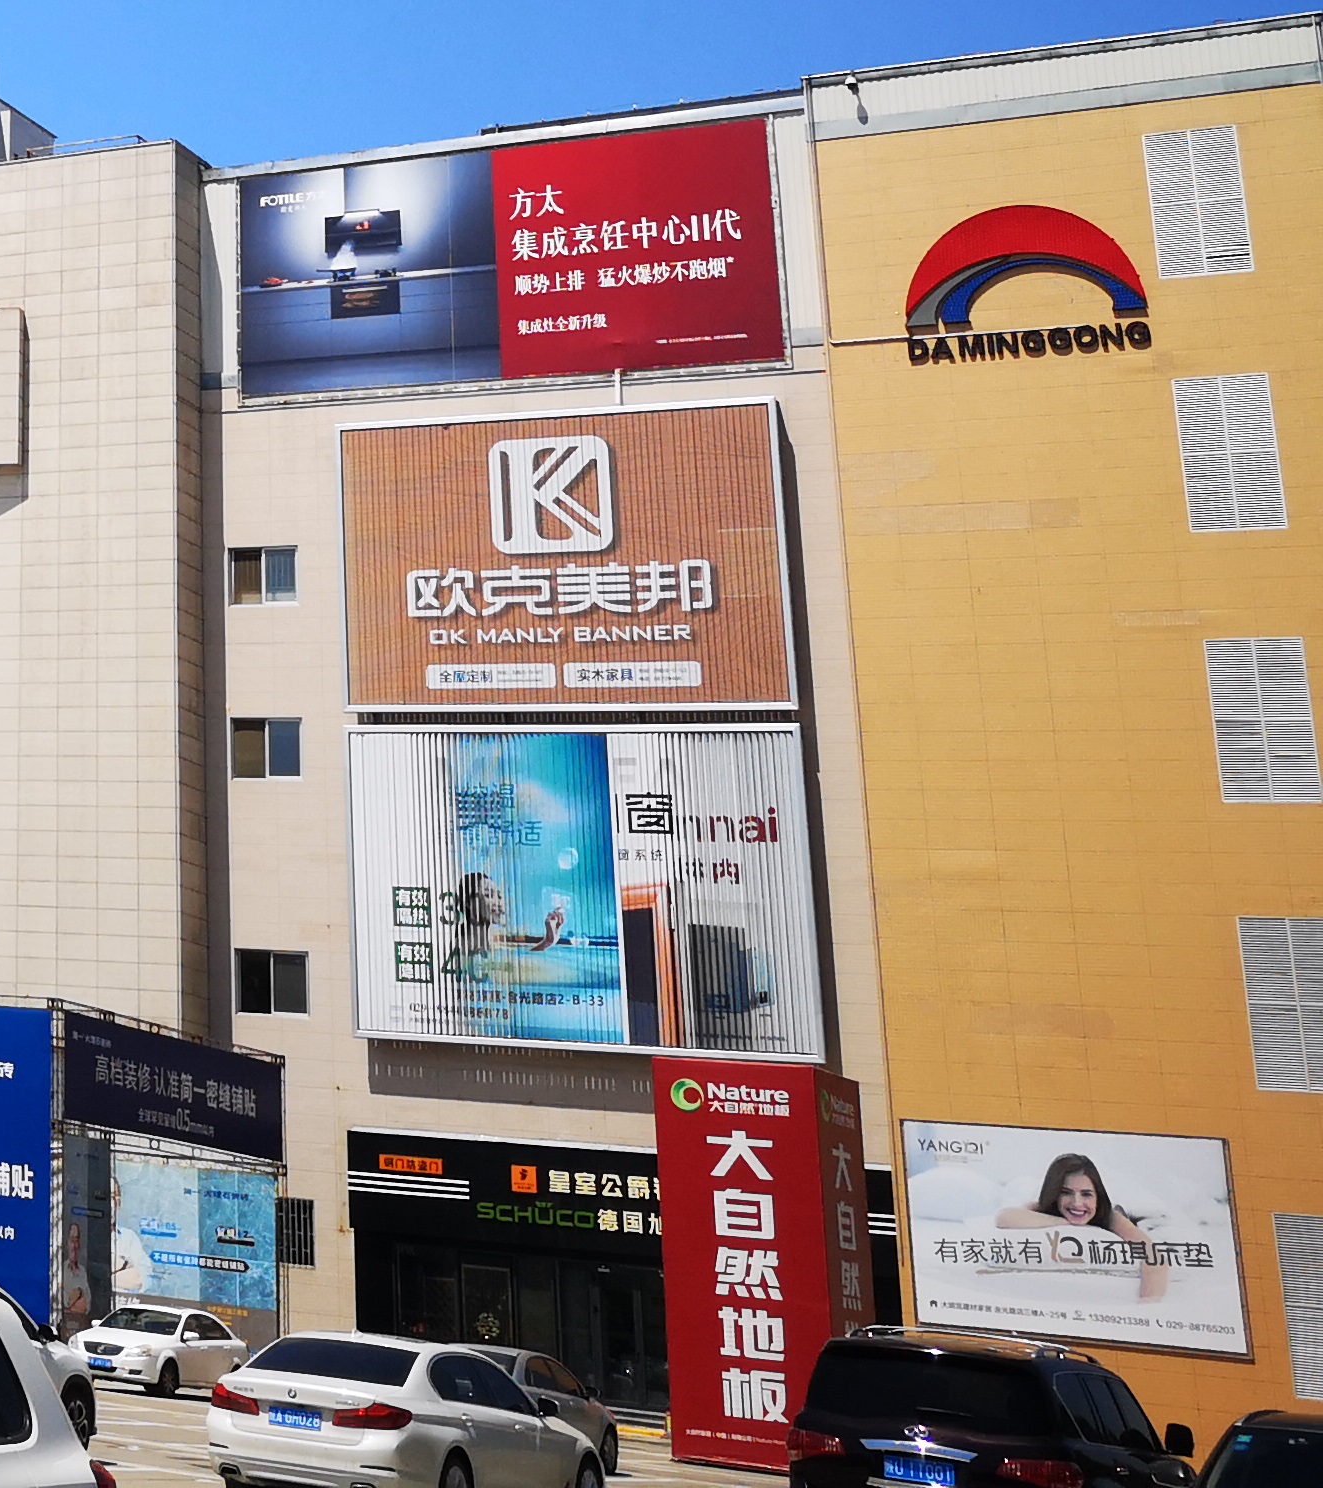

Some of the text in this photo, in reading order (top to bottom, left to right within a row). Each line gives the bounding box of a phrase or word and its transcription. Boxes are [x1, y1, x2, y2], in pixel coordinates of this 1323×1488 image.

[260, 193, 303, 207] FOTILE
[509, 184, 565, 221] 方太
[514, 269, 586, 296] 顺势上排
[518, 313, 607, 335] 集成灶全新升级
[907, 321, 1151, 366] DAMINGGONG
[406, 558, 713, 618] 欧克美邦
[477, 626, 562, 645] MANLY
[574, 623, 692, 643] BANNER
[440, 670, 492, 683] 全屋定制
[577, 668, 633, 681] 实木家具
[95, 1053, 151, 1093] 高档装修
[708, 1083, 789, 1104] Nature
[709, 1101, 789, 1117] 大自然地板
[476, 1202, 595, 1229] SCHÜCO
[934, 1238, 1043, 1264] 有家就有
[1088, 1239, 1213, 1267] 杨琪床垫
[705, 1130, 789, 1424] 大自然地板
